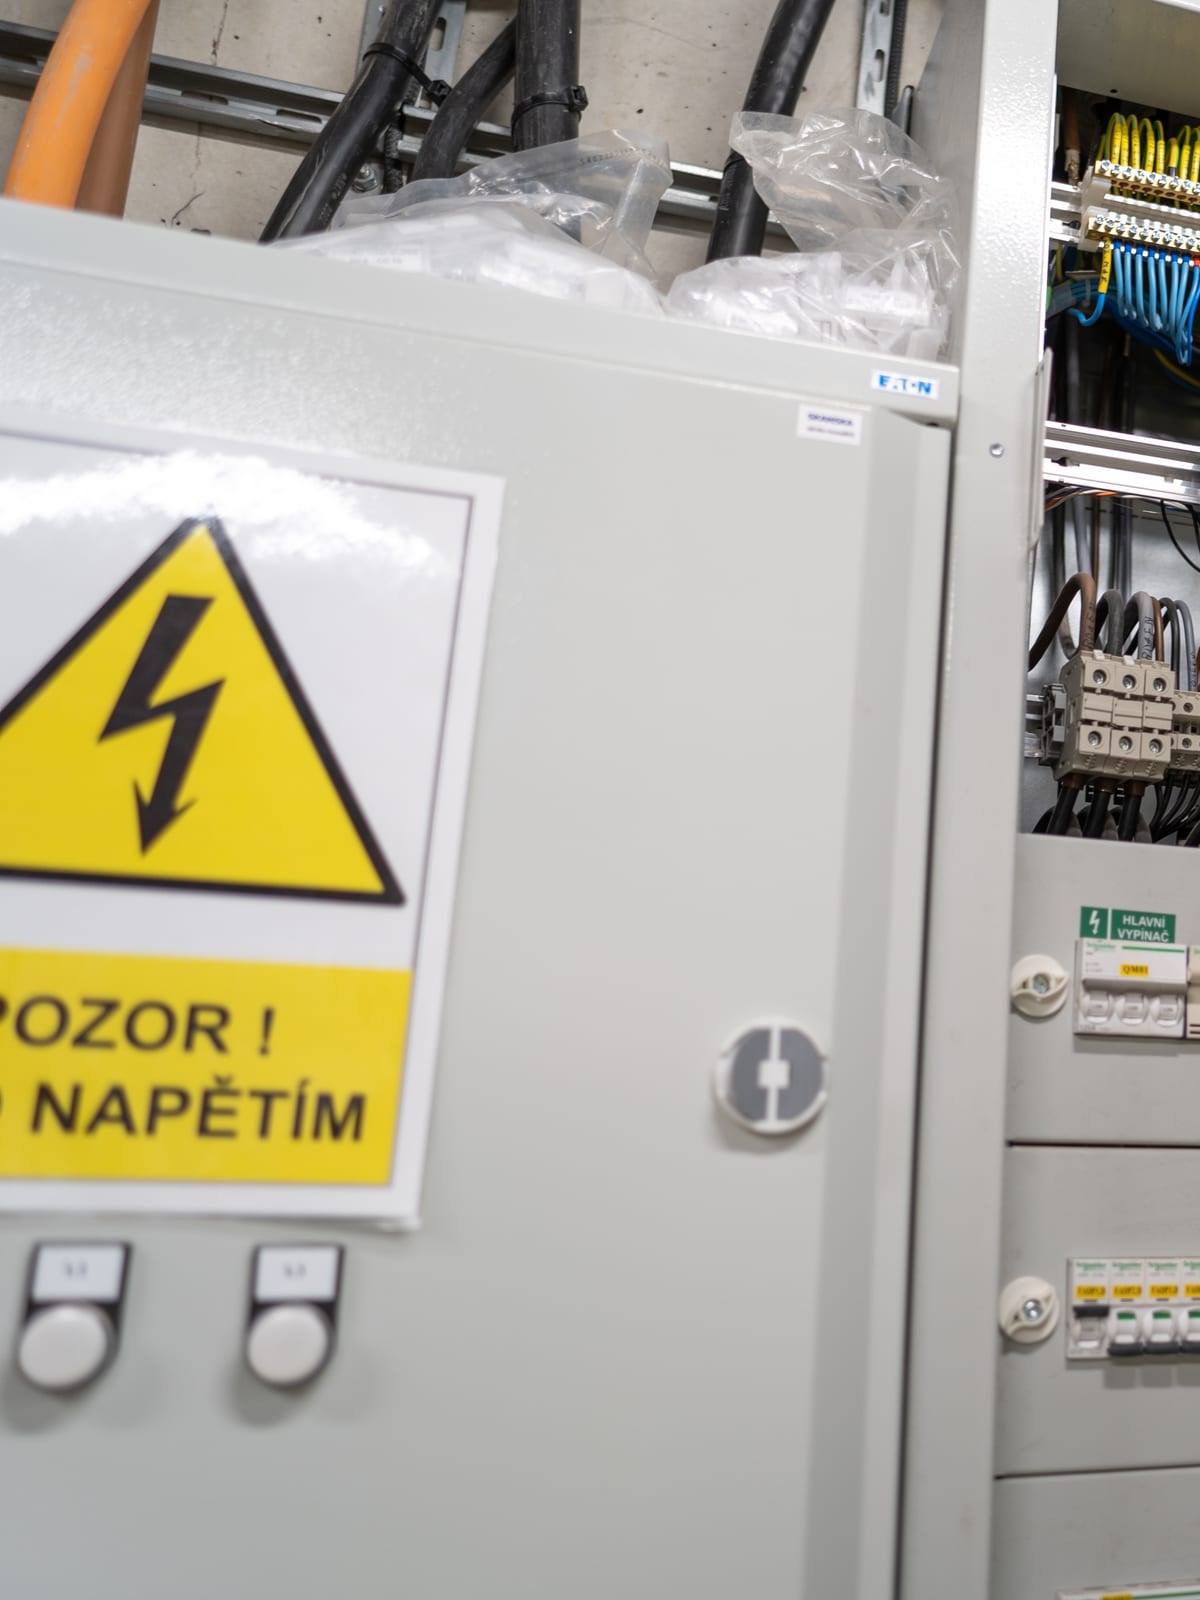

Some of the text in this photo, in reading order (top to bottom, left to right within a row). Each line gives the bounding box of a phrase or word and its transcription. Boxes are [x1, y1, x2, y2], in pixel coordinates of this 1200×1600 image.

[1117, 928, 1170, 943] VYPÍNAČ
[1122, 914, 1166, 929] HLAVNÍ
[0, 994, 276, 1056] OZOR !
[29, 1073, 367, 1143] NAPĚTÍM
